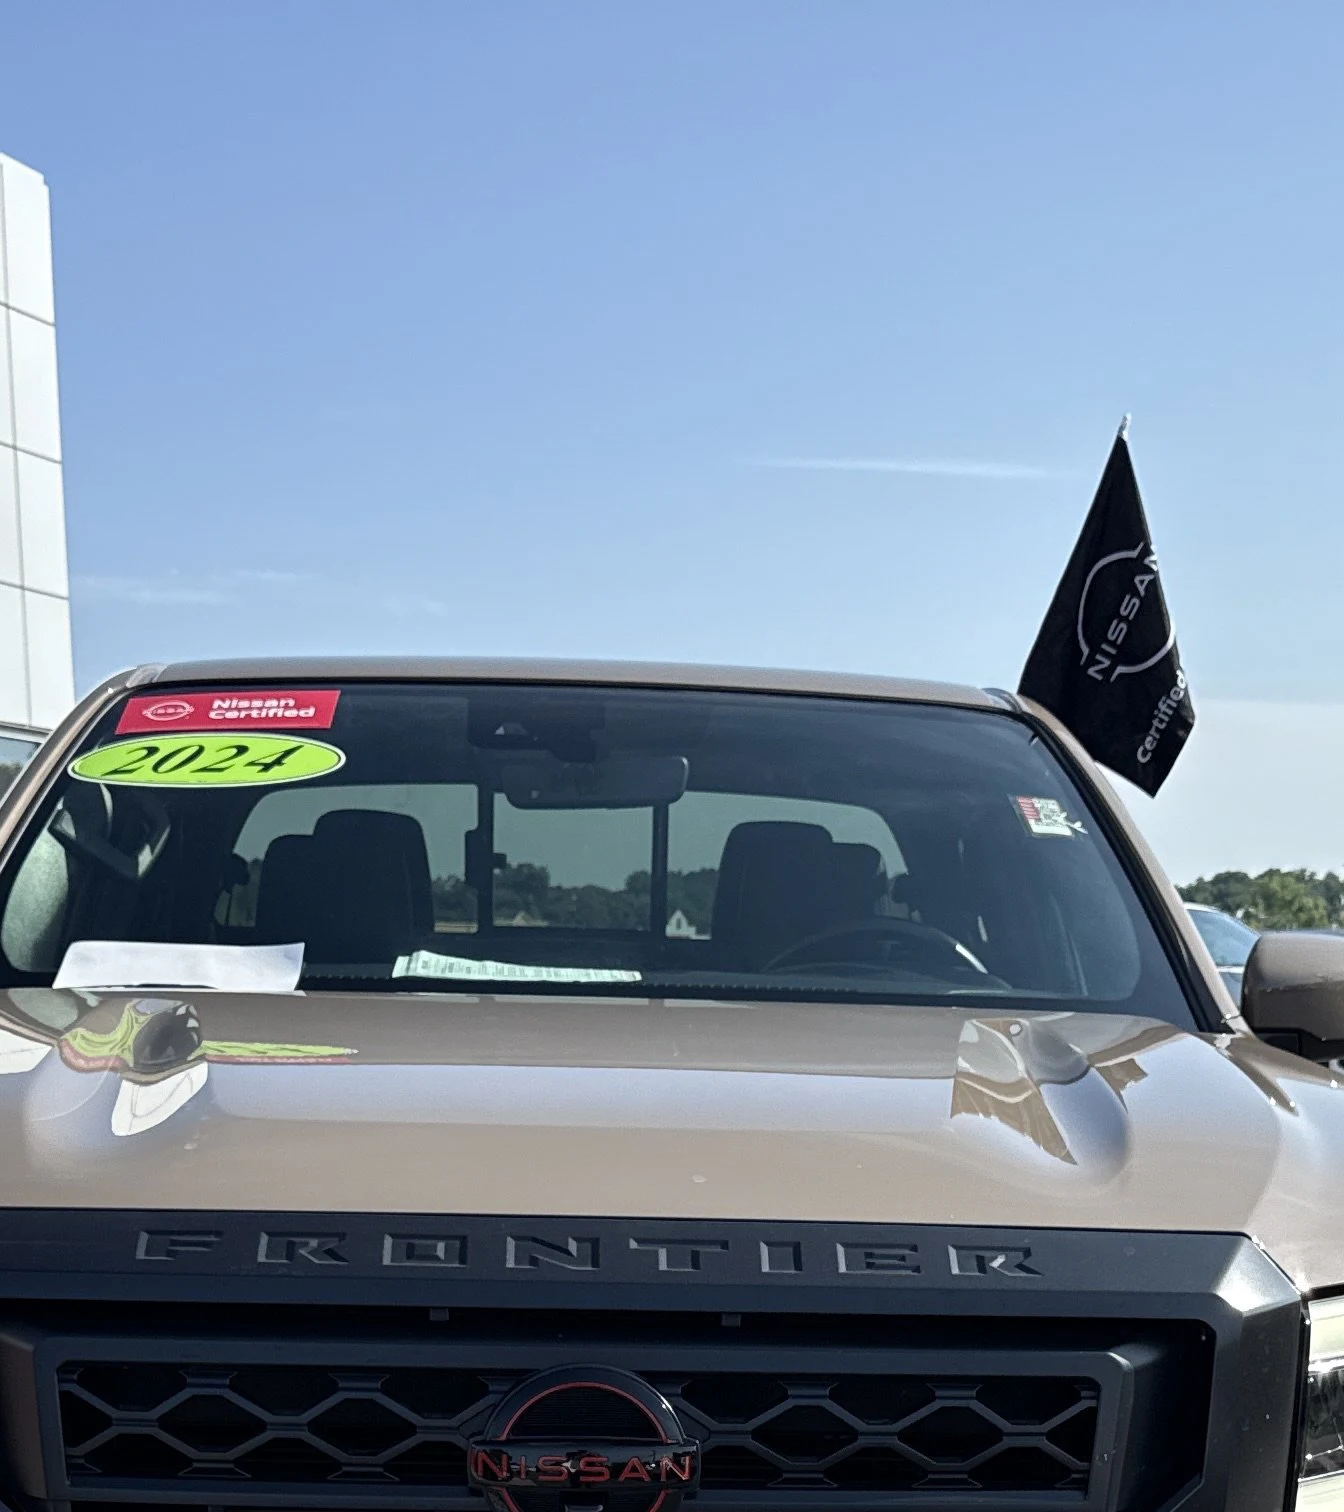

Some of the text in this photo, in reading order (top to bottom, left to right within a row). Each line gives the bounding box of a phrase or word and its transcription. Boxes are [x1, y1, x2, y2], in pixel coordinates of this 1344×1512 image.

[208, 706, 316, 720] Certified
[211, 698, 295, 710] Nissan
[1137, 669, 1186, 763] Certified
[100, 744, 305, 777] 2024
[135, 1229, 1045, 1278] FRONTIER
[476, 1450, 691, 1482] NISSAN
